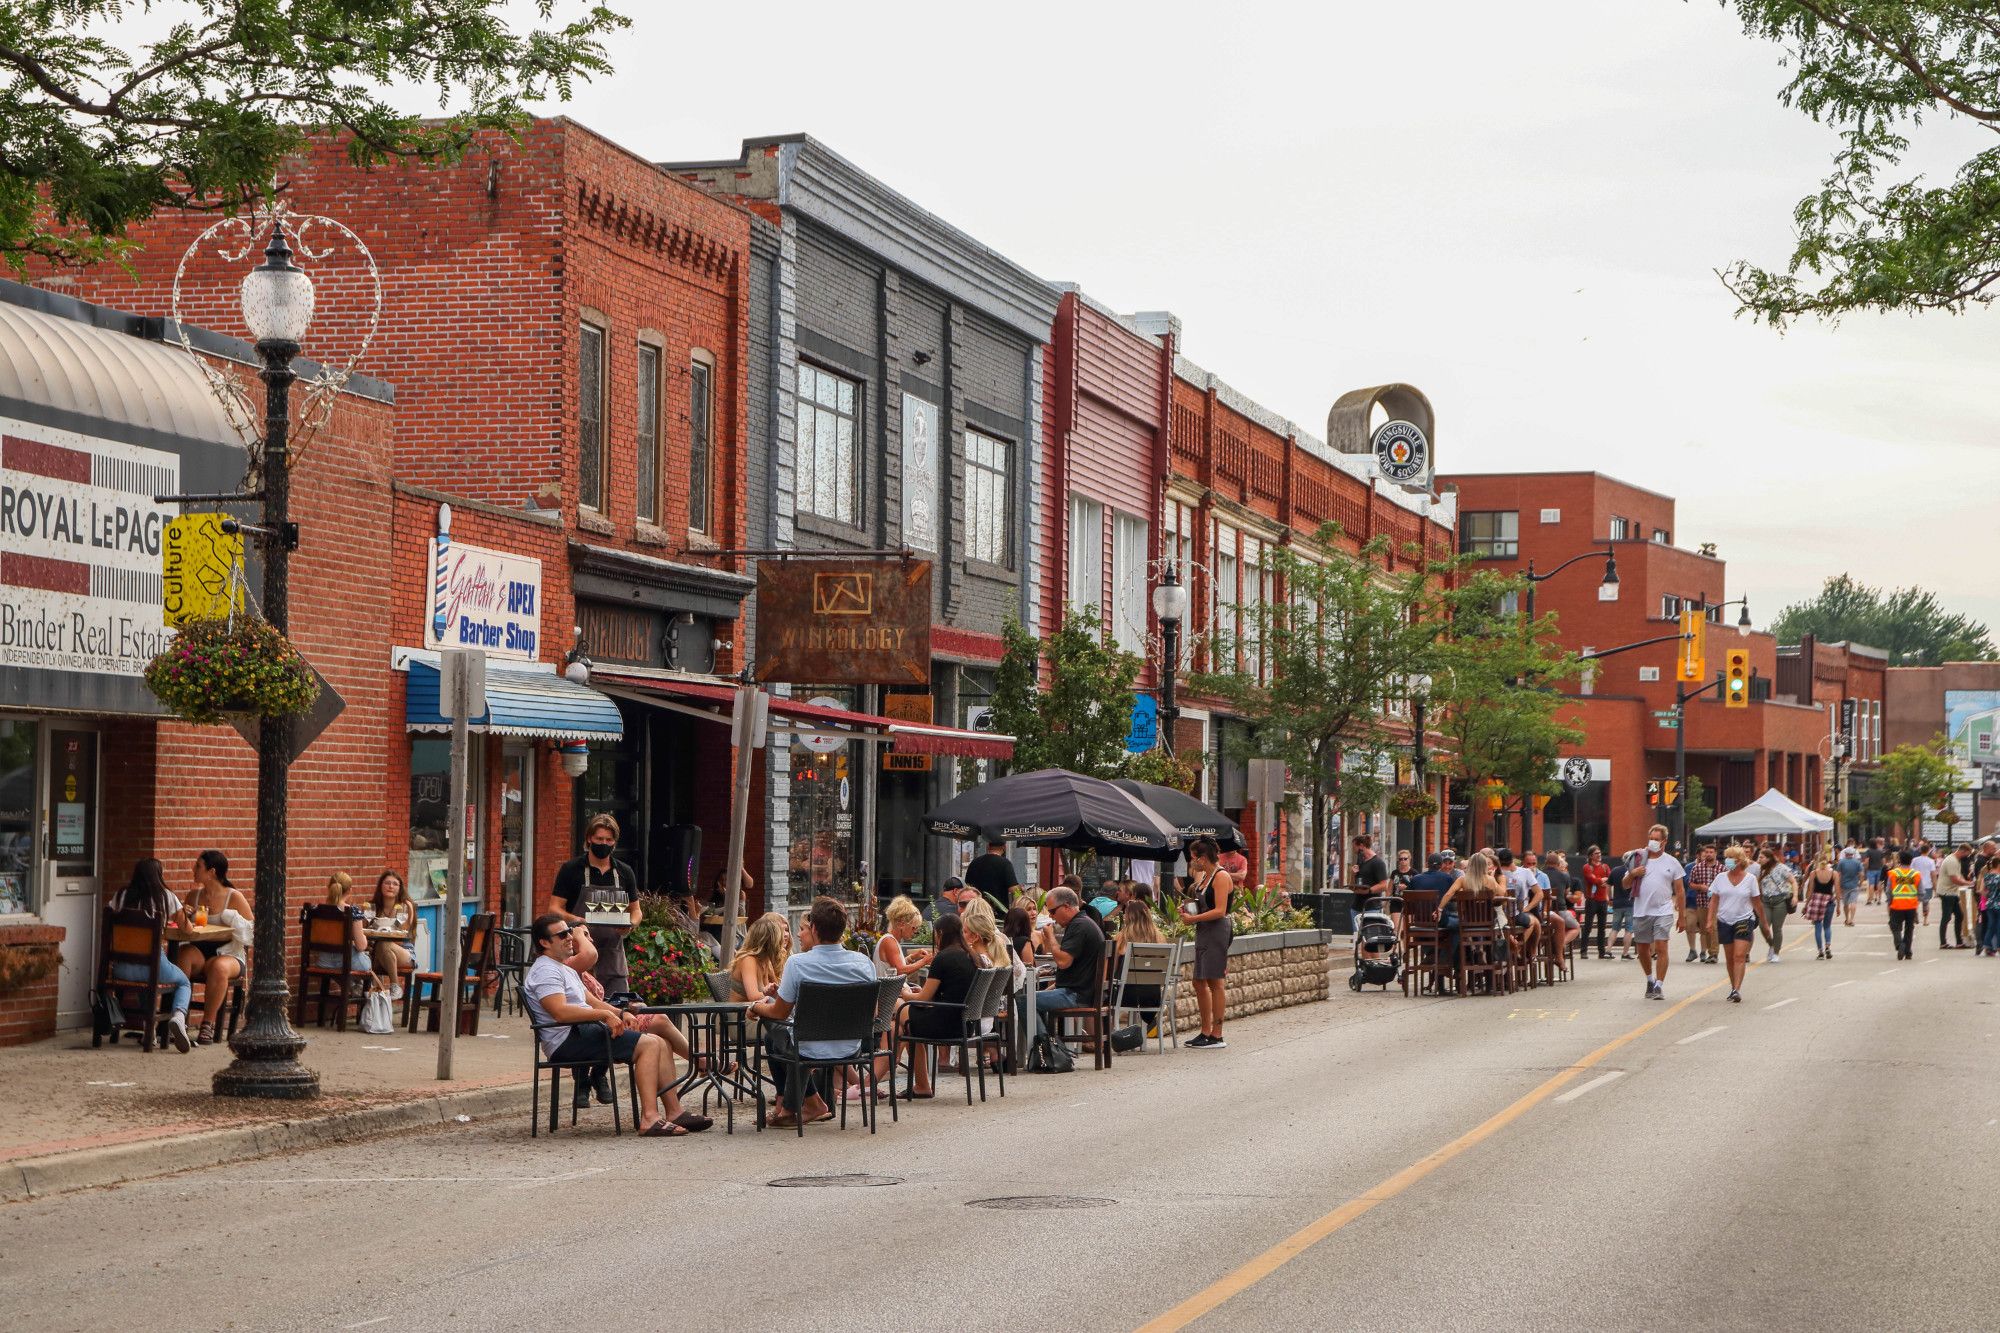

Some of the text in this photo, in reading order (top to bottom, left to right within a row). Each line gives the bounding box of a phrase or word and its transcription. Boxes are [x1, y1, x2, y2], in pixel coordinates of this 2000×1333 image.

[1380, 425, 1421, 446] KINGSVILLE
[1379, 450, 1424, 478] TOWN SQUARE
[1, 485, 84, 545] ROYAL
[163, 527, 183, 613] Culture
[507, 581, 535, 616] APEX
[1, 603, 65, 651] Binder
[72, 612, 112, 657] Real
[459, 615, 536, 659] Barber Shop
[781, 625, 905, 650] WINEOLOGY
[2, 649, 56, 666] INDEPENDENTLY
[57, 654, 82, 669] OWNED
[82, 657, 97, 670] AND
[934, 820, 950, 830] PELEE
[1097, 827, 1120, 837] PELEE
[1122, 830, 1148, 843] ISLAND
